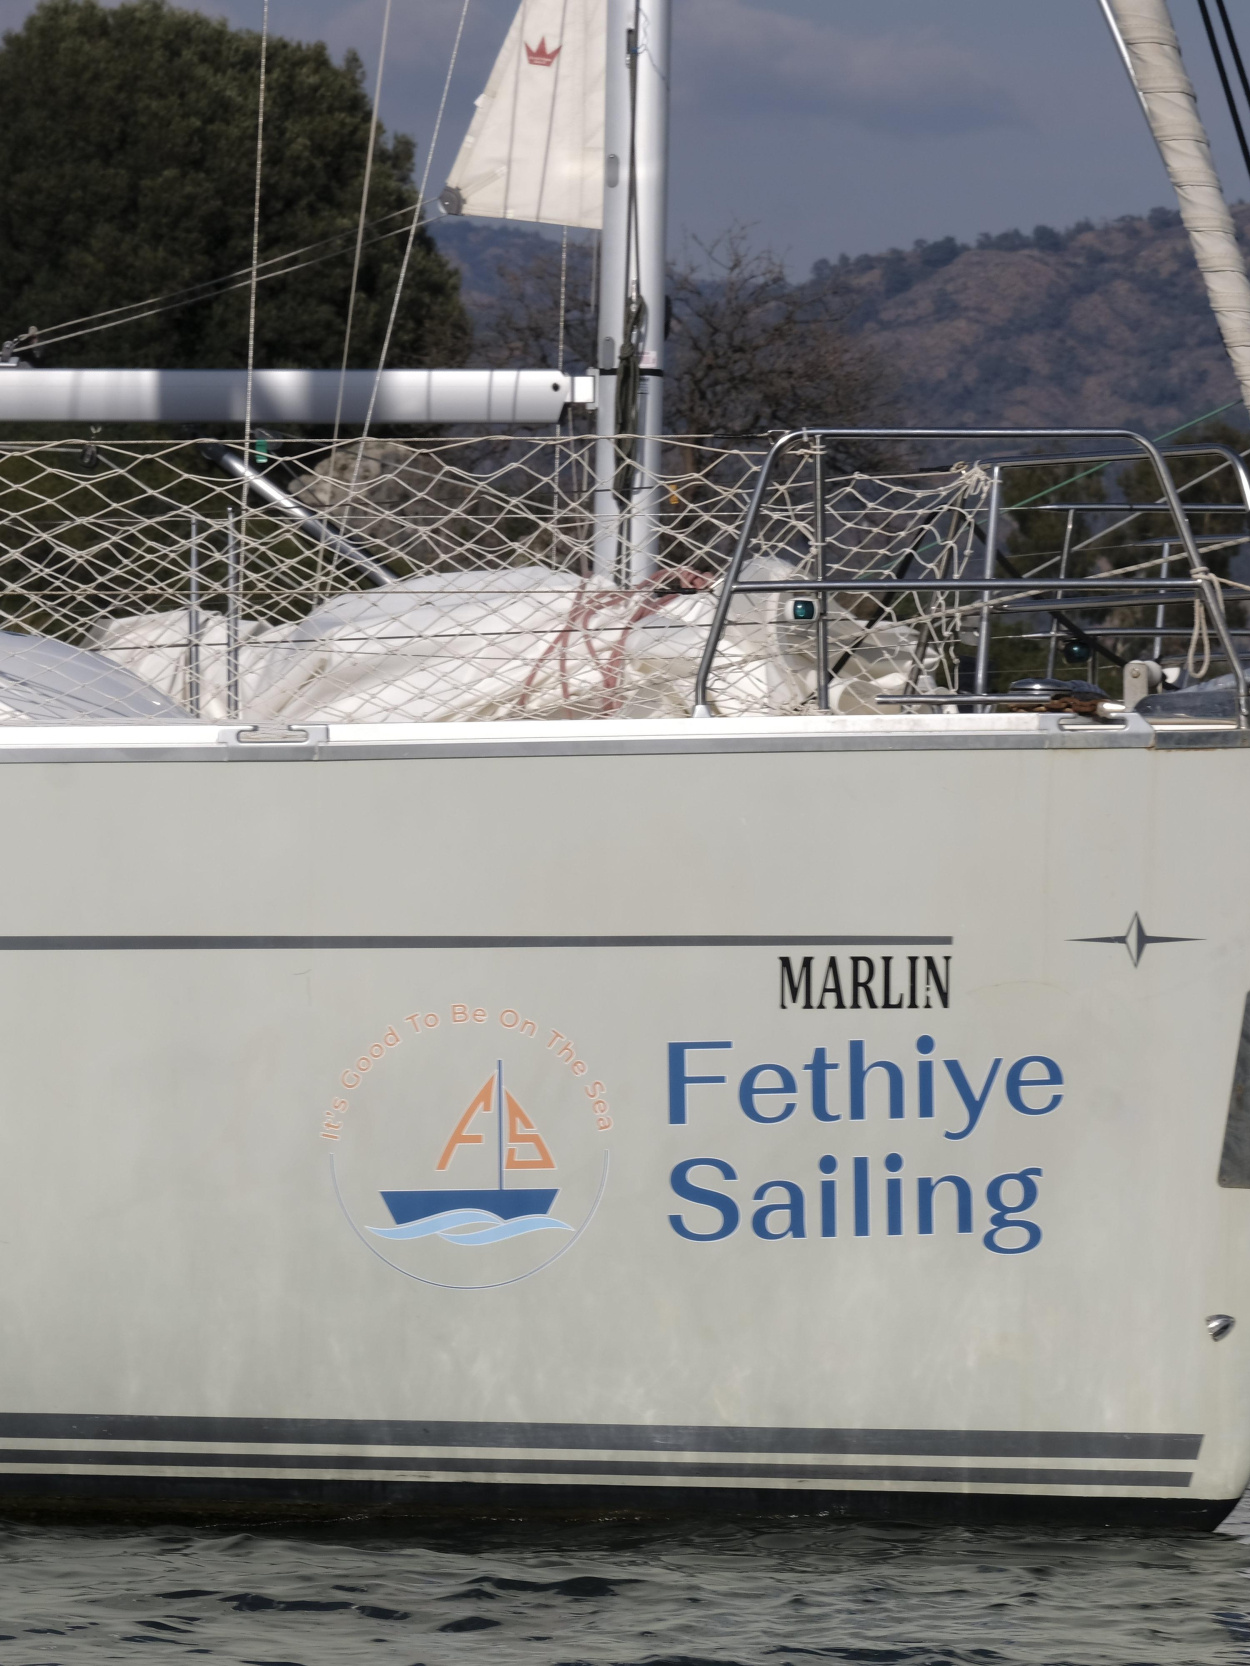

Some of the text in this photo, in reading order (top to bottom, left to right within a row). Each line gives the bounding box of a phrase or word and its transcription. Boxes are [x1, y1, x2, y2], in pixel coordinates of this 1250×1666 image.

[778, 955, 952, 1010] MARLIN
[320, 1003, 614, 1141] It's Good To Be On The Sea
[667, 1034, 1064, 1141] Fethiye
[667, 1153, 1043, 1255] Sailing
